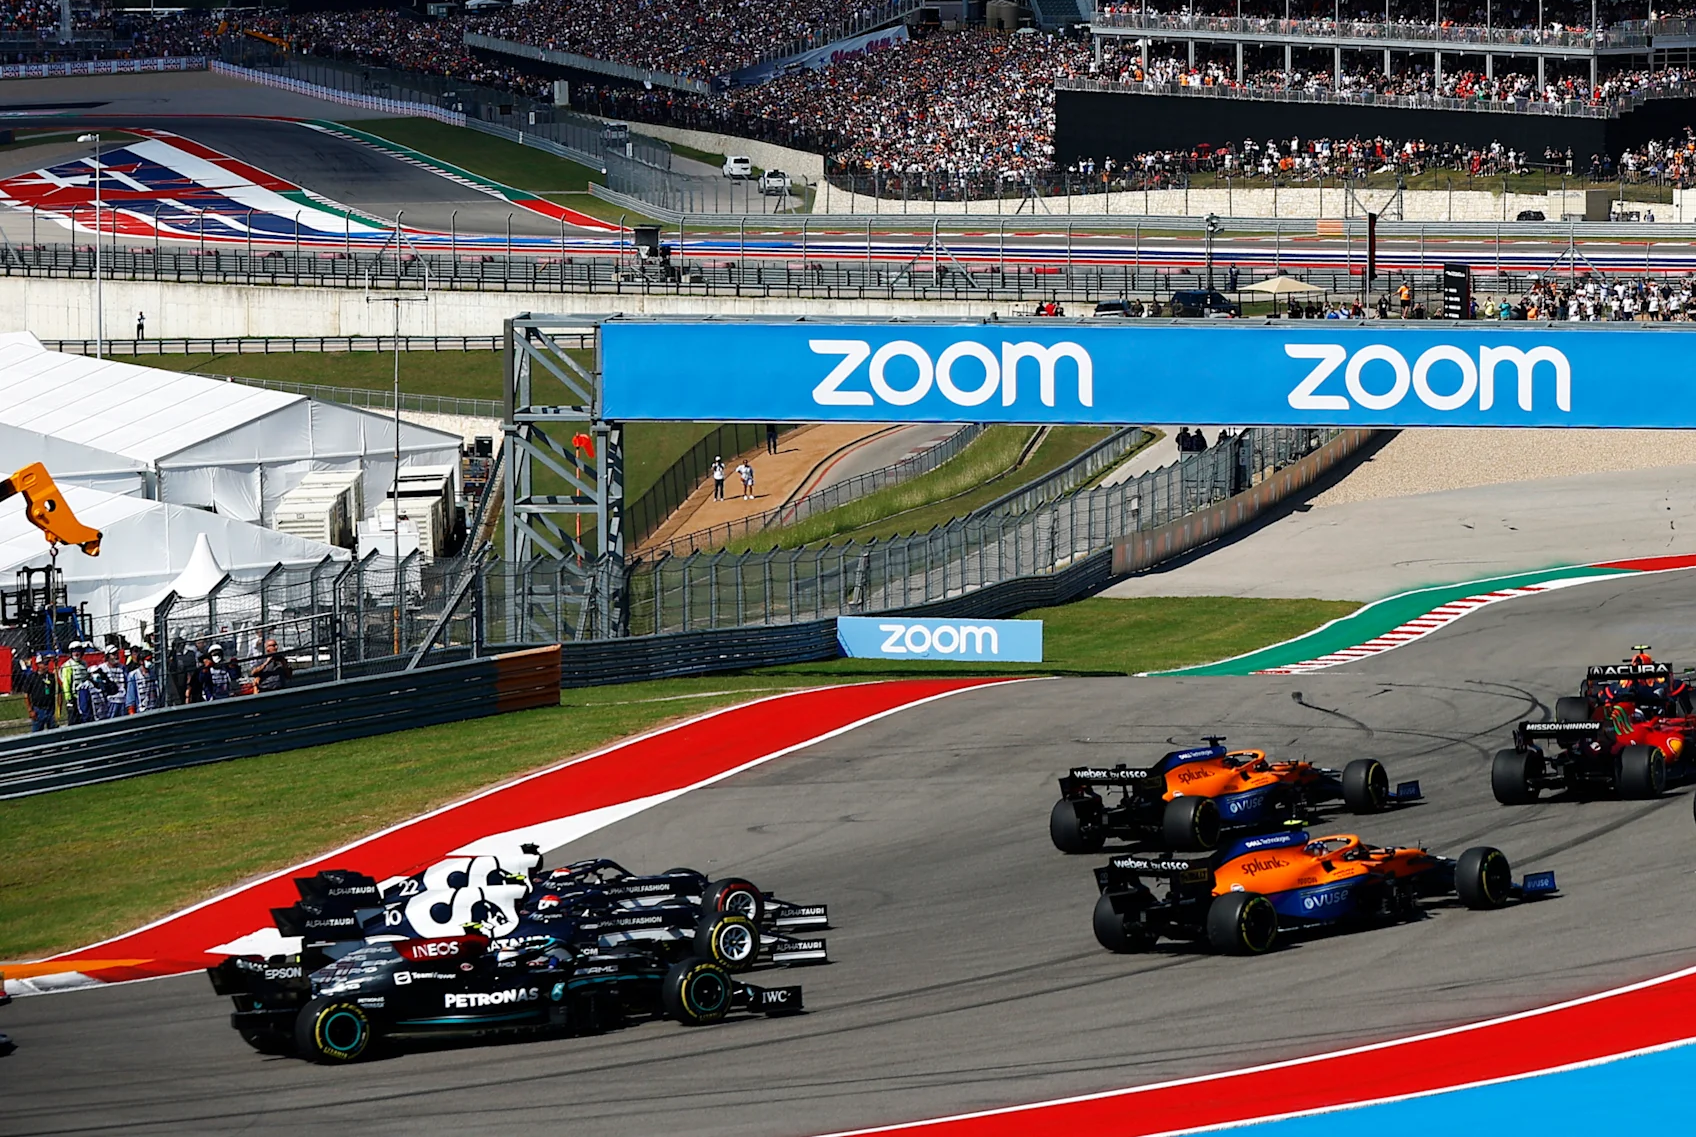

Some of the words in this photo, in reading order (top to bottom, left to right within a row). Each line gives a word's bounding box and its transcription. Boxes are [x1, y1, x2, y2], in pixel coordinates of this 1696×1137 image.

[809, 340, 1093, 407] zoom
[1285, 344, 1571, 411] zoom
[879, 624, 998, 655] zoom
[1605, 664, 1670, 675] ACURA
[1526, 722, 1563, 731] MISSION
[1563, 722, 1600, 730] WINNOW
[1074, 769, 1107, 779] webex
[1114, 857, 1148, 869] webex
[328, 886, 375, 896] ALPHATAURI
[399, 880, 420, 896] 22
[383, 909, 402, 926] 10
[780, 907, 824, 917] ALPHATAURI
[305, 917, 354, 928] ALPHATAURI
[412, 941, 459, 958] INEOS
[776, 941, 822, 952] ALPHATAURI
[265, 966, 302, 980] EPSON
[445, 987, 539, 1008] PETRONAS
[762, 991, 787, 1003] IWC
